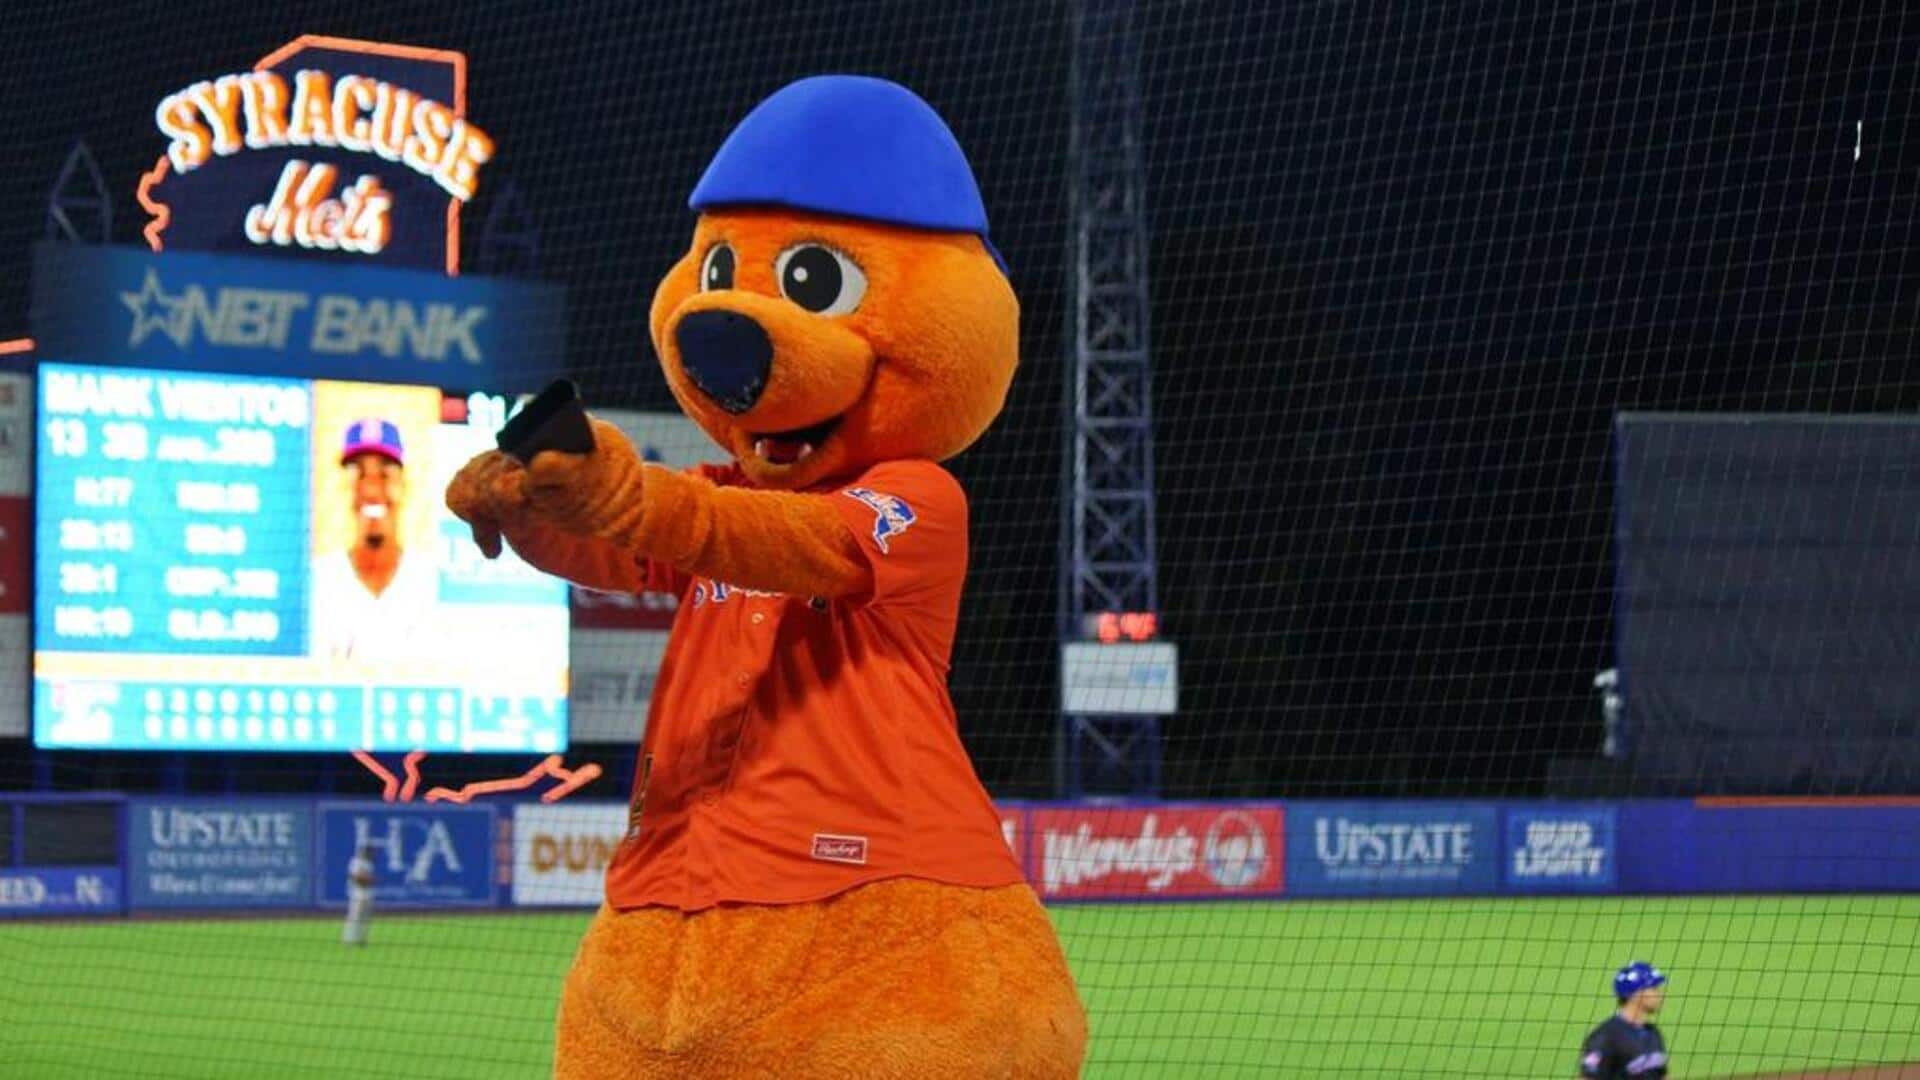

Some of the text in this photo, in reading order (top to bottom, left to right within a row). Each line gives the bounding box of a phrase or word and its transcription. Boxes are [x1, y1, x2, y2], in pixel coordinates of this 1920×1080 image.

[156, 69, 497, 201] SYRACUSE
[245, 160, 391, 254] Mets
[182, 285, 488, 362] NBT BANK
[46, 372, 154, 419] MARK
[150, 808, 296, 847] UPSTATE
[1043, 813, 1199, 894] Wendy's
[1315, 816, 1472, 866] UPSTATE
